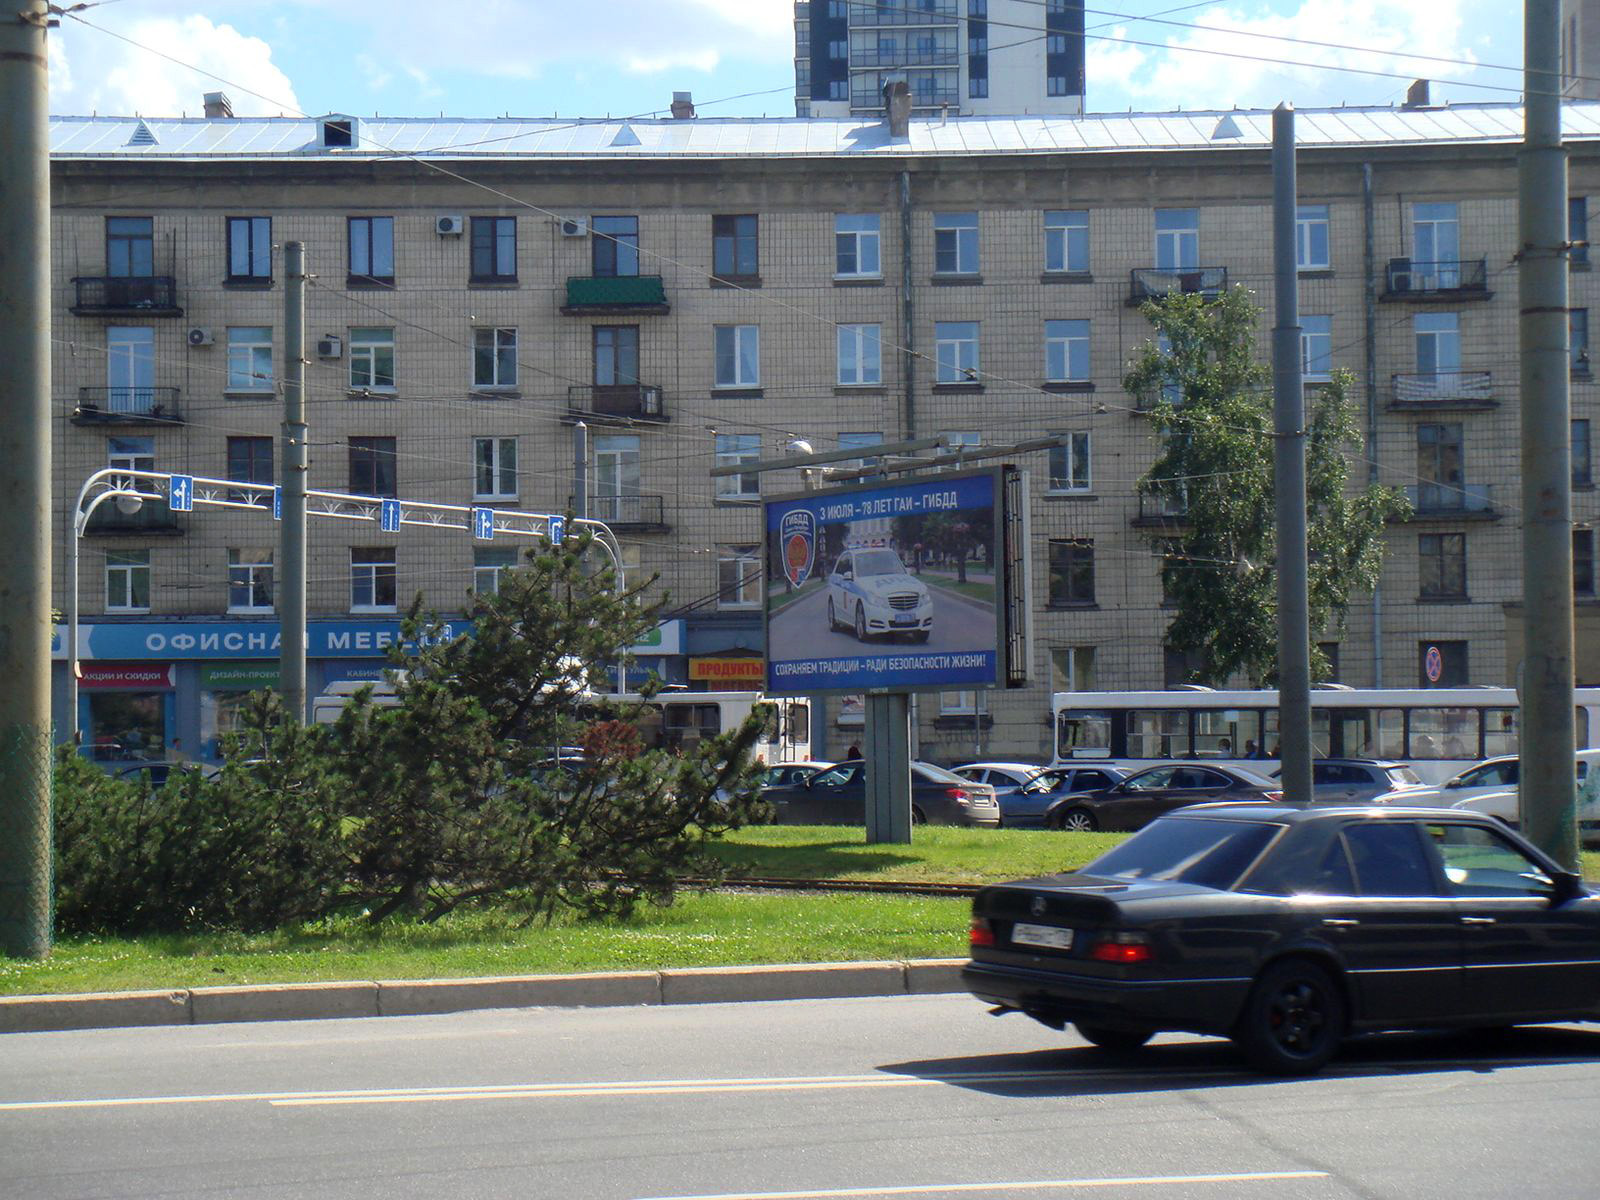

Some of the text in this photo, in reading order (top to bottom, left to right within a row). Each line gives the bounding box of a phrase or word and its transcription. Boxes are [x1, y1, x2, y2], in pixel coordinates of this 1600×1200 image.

[820, 507, 826, 520] 3
[827, 503, 854, 520] ИЮЛЯ
[862, 501, 872, 515] 78
[873, 499, 893, 514] ЛЕТ
[894, 496, 913, 512] ГАИ
[922, 491, 958, 510] ГИБДД
[785, 513, 809, 527] ГИБДД
[145, 632, 309, 651] ОФИСНА
[698, 662, 764, 677] ПРОДУКТЫ
[775, 660, 817, 676] СОХРАНЯЕМ
[818, 658, 860, 675] ТРАДИЦИИ
[866, 659, 887, 673] РАДИ
[888, 655, 950, 670] БЕЗОПАСНОСТИ
[951, 654, 987, 668] ЖИЗНИ!
[84, 672, 161, 682] АКЦИИ И СКИДКИ
